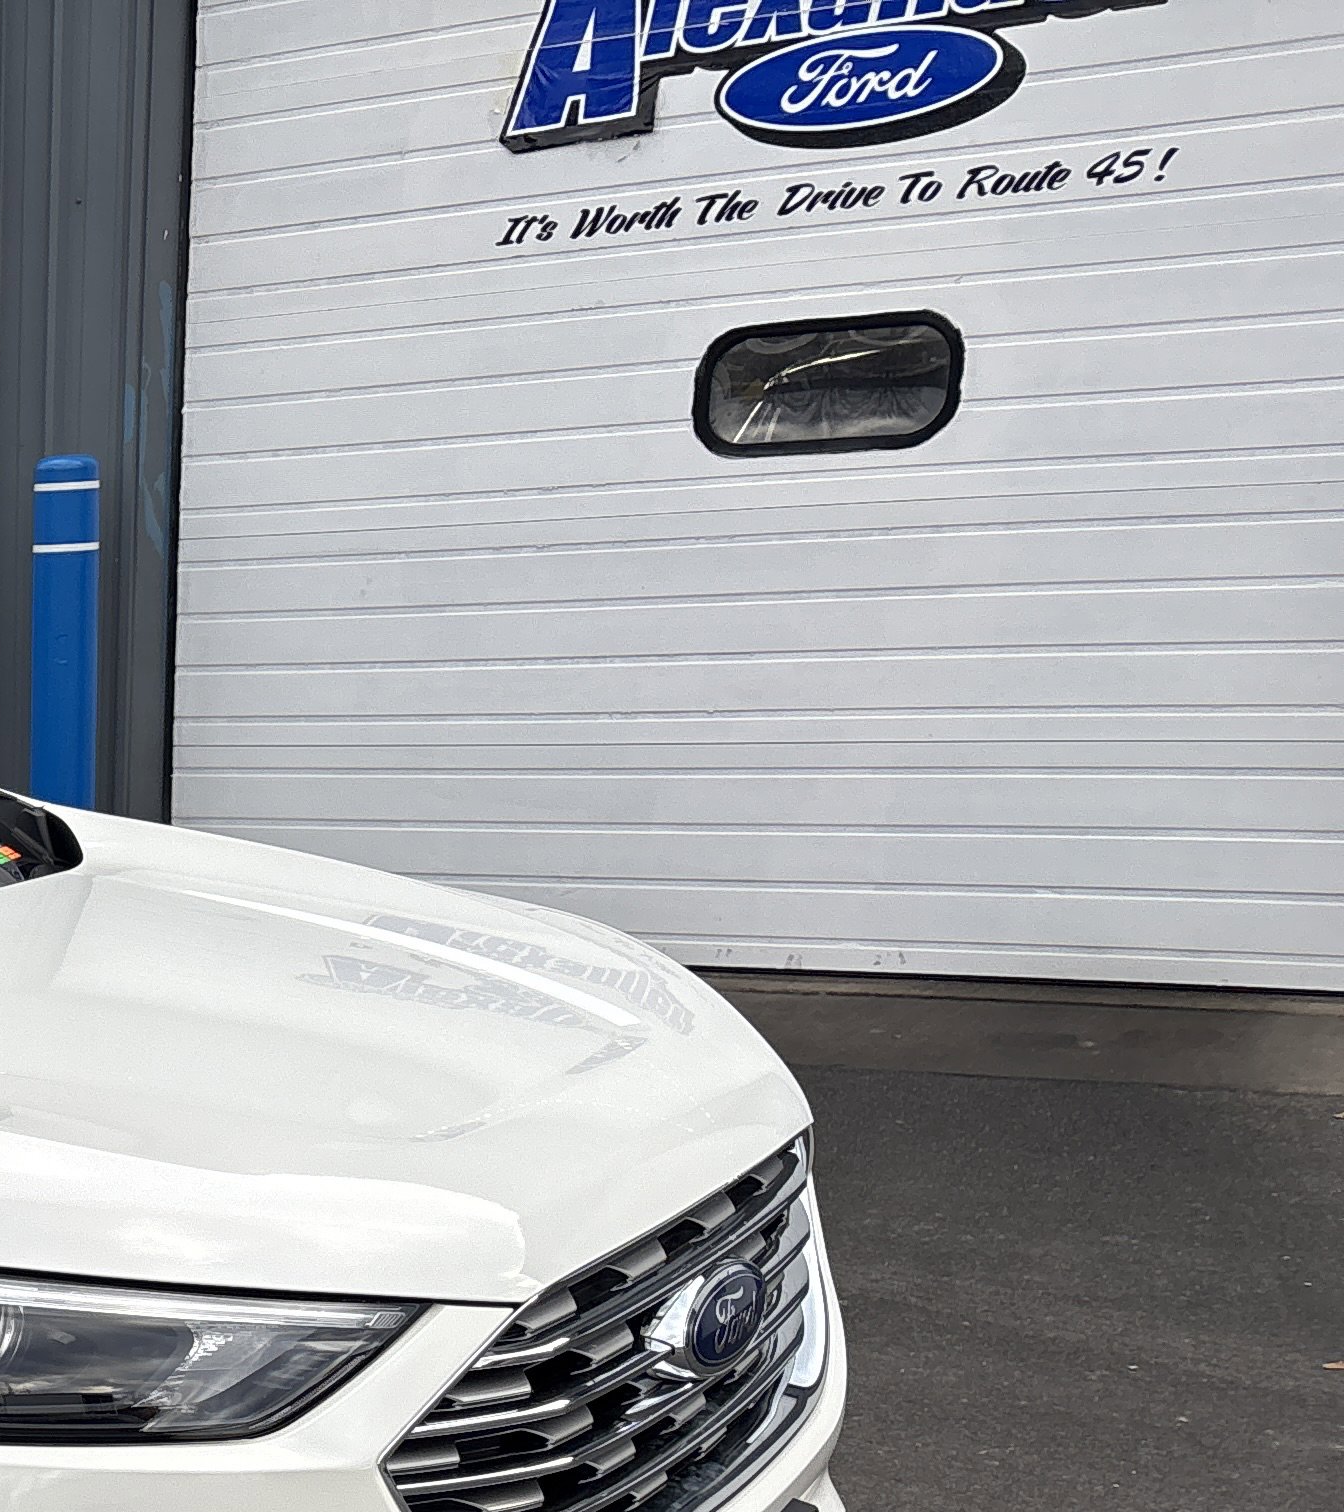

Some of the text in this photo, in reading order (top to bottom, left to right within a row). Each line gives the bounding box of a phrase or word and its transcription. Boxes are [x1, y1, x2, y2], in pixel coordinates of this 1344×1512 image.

[780, 44, 933, 115] Ford
[495, 214, 559, 247] It's
[569, 196, 682, 240] Worth
[695, 189, 759, 226] The
[776, 181, 887, 217] Drive
[897, 169, 944, 204] To
[955, 159, 1072, 200] Route
[714, 1285, 757, 1354] Ford
